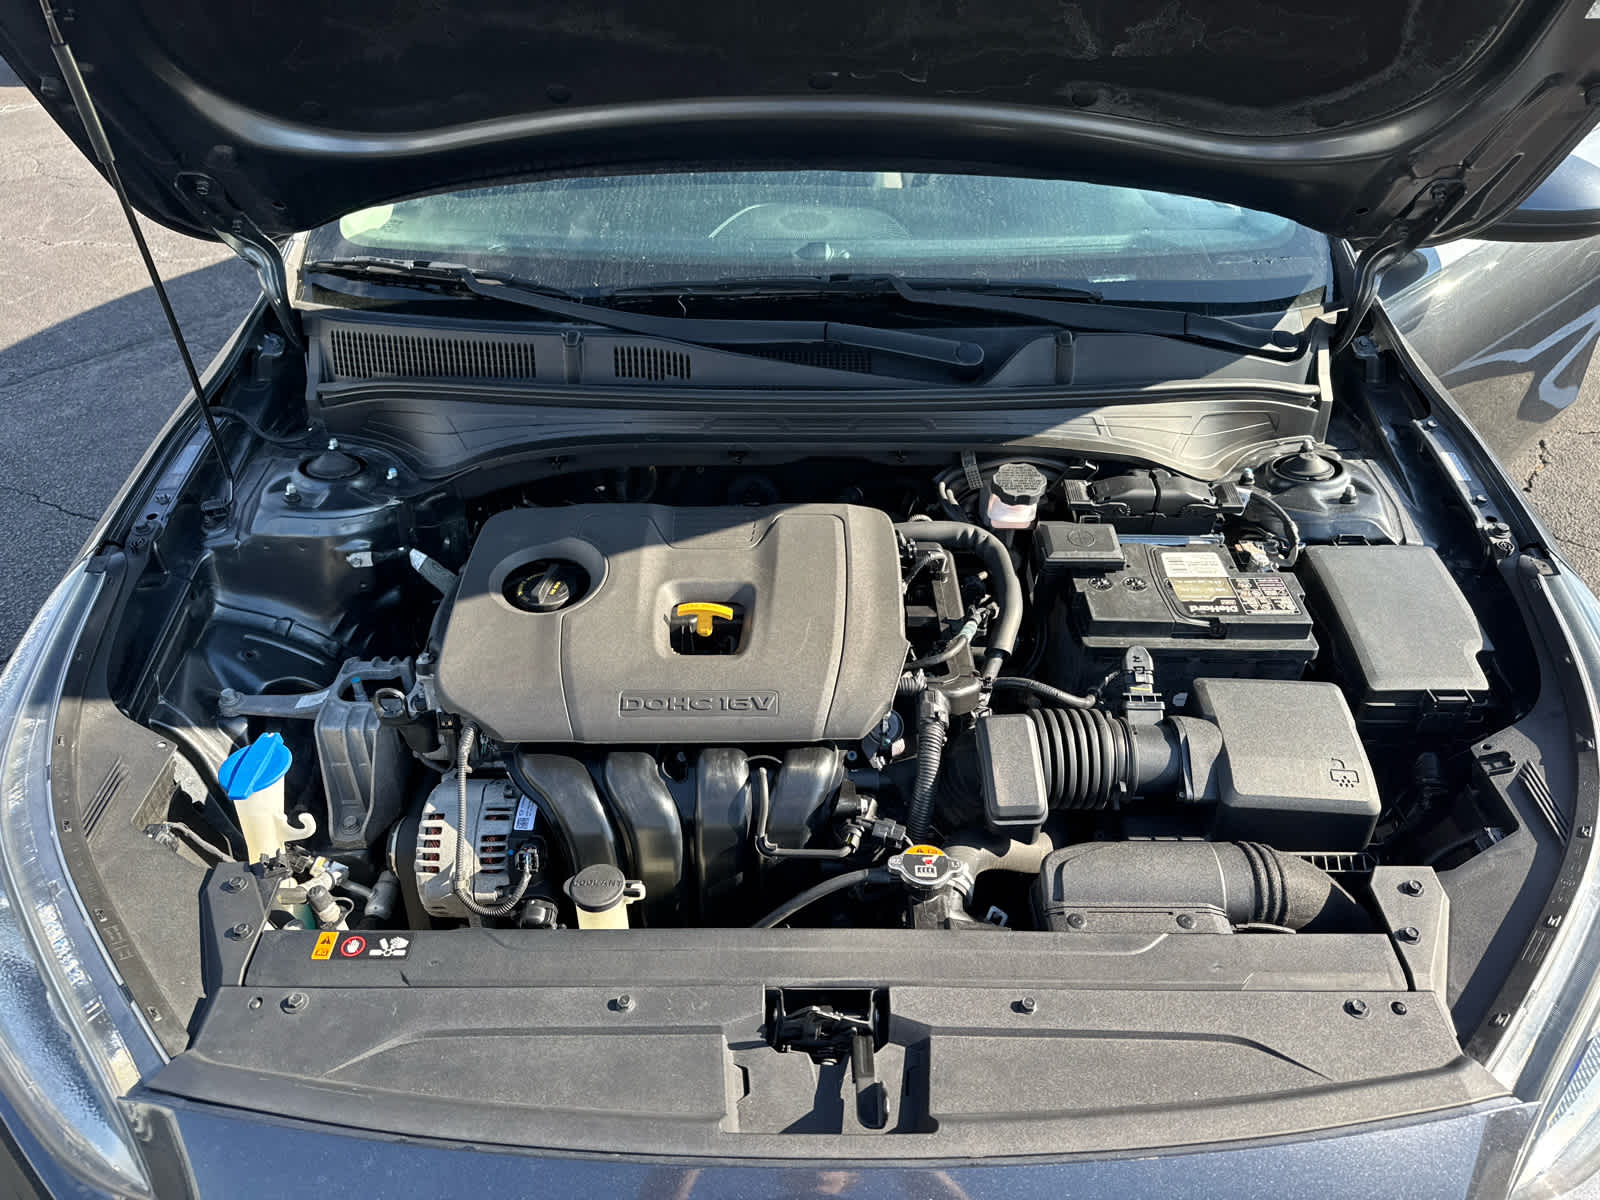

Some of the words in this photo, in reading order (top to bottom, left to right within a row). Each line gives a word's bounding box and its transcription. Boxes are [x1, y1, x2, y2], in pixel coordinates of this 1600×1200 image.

[1189, 605, 1239, 614] DieHard
[620, 695, 713, 711] DOHC
[720, 695, 776, 711] 16V
[573, 879, 623, 889] COOLANT
